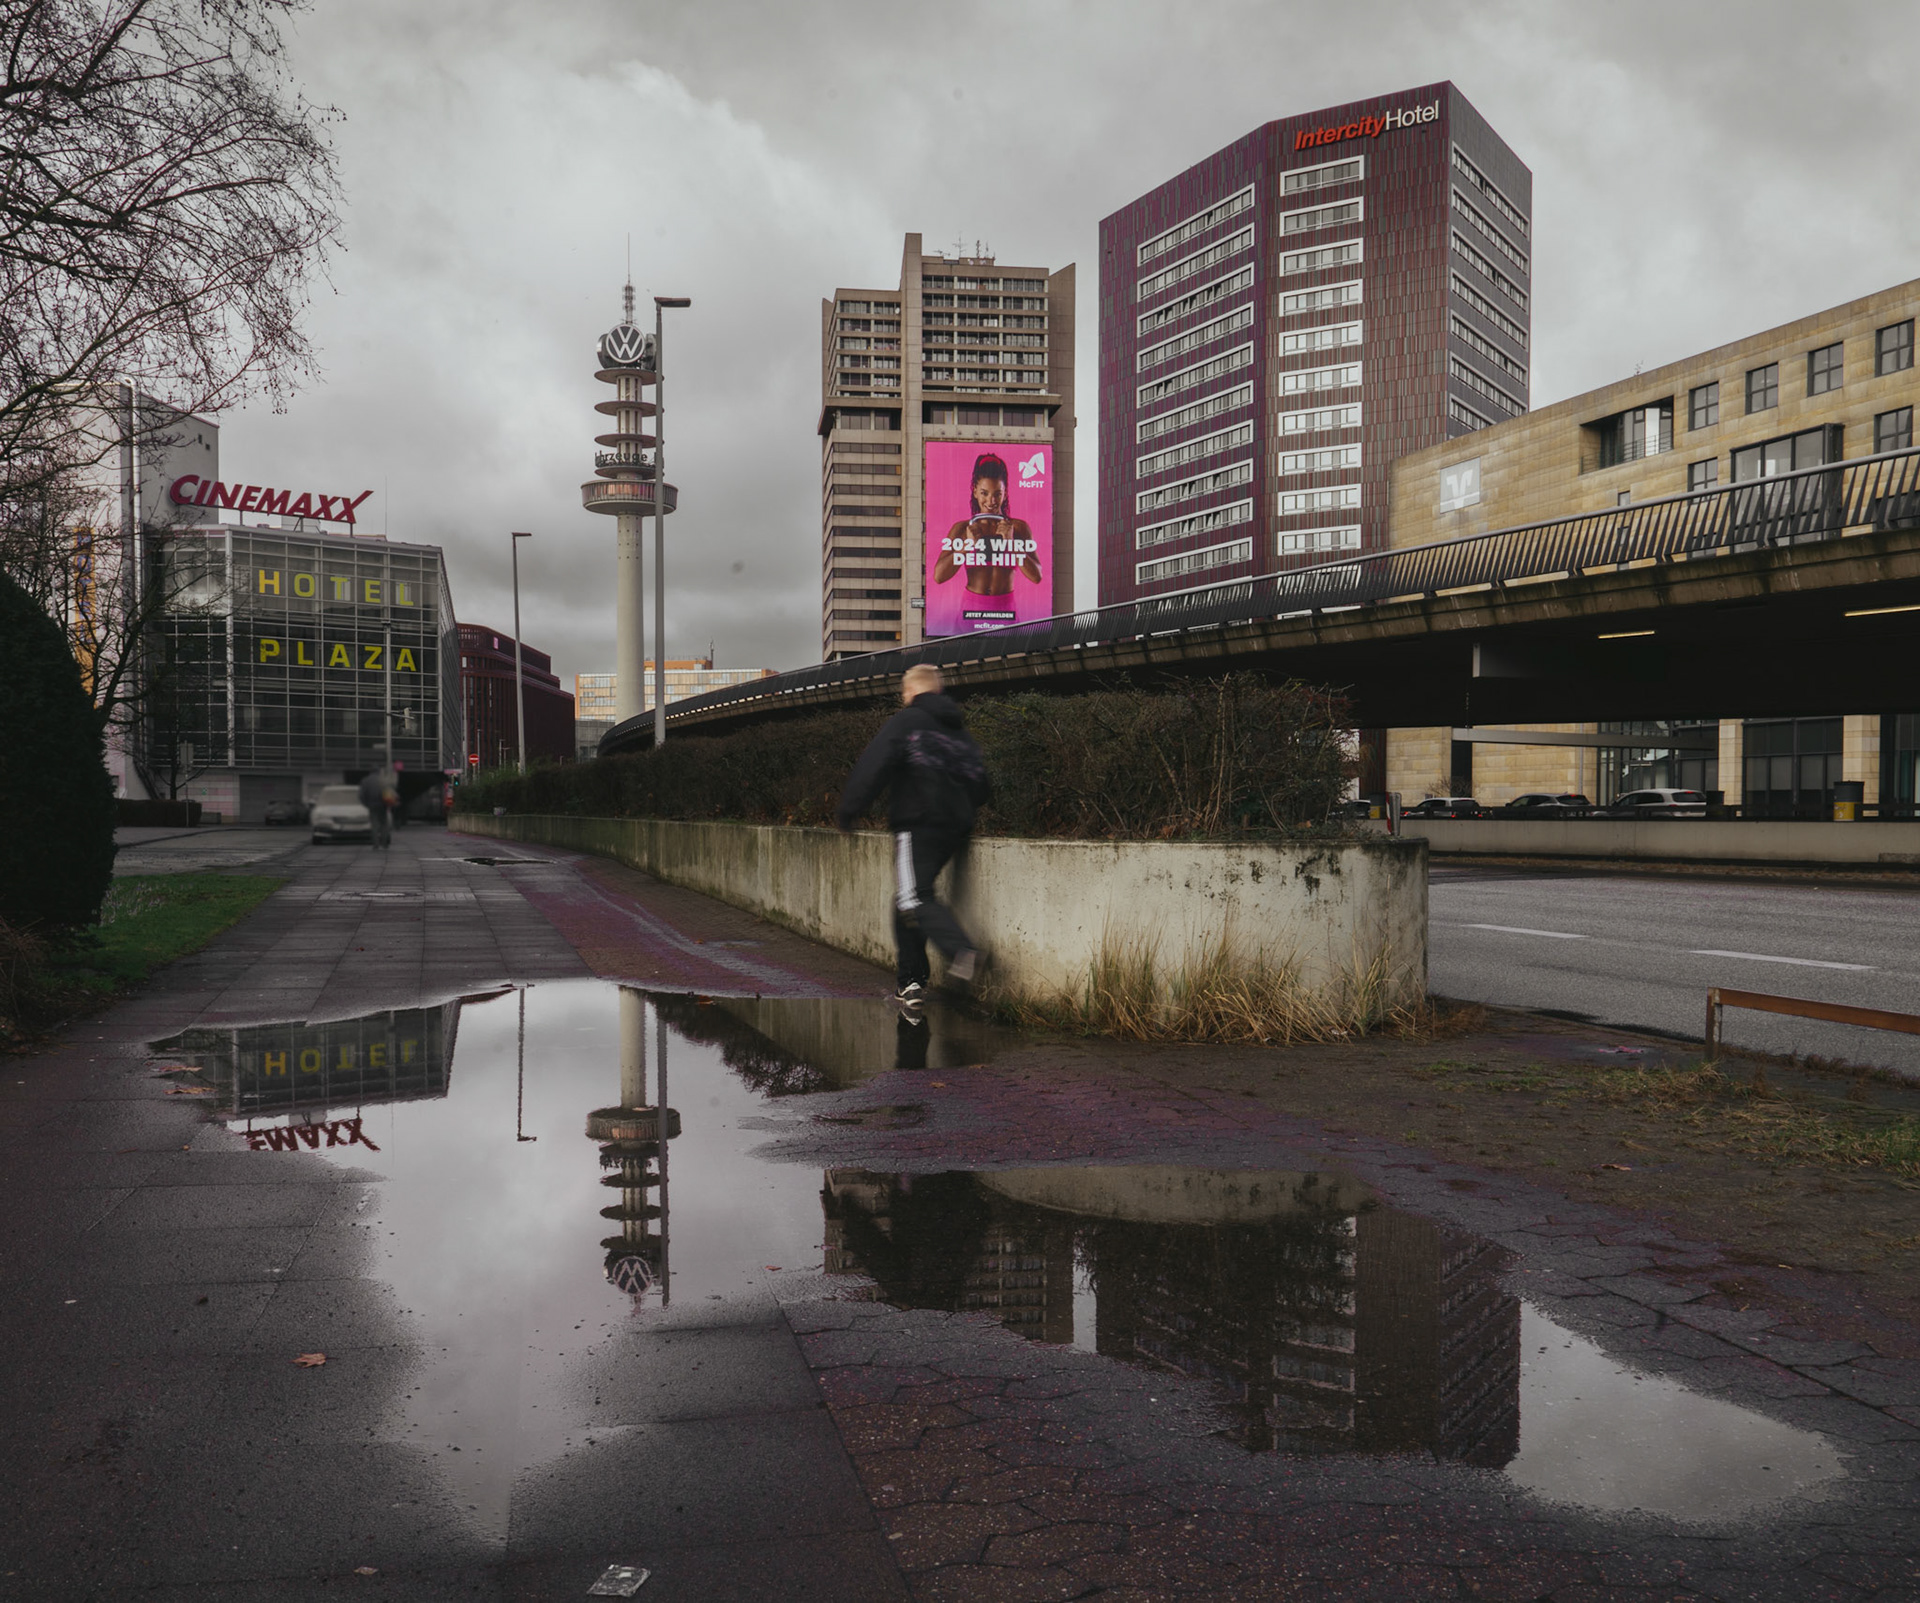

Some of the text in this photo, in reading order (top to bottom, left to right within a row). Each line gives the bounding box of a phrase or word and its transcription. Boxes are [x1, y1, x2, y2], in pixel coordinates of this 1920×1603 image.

[1295, 100, 1439, 150] IntercityHotel
[169, 475, 374, 524] CINEMAXX
[1019, 480, 1045, 488] McFIT
[941, 538, 1037, 552] 2024 WIRD
[953, 552, 1026, 566] DER HIIT
[258, 569, 414, 606] HOTEL
[259, 638, 417, 672] PLAZA
